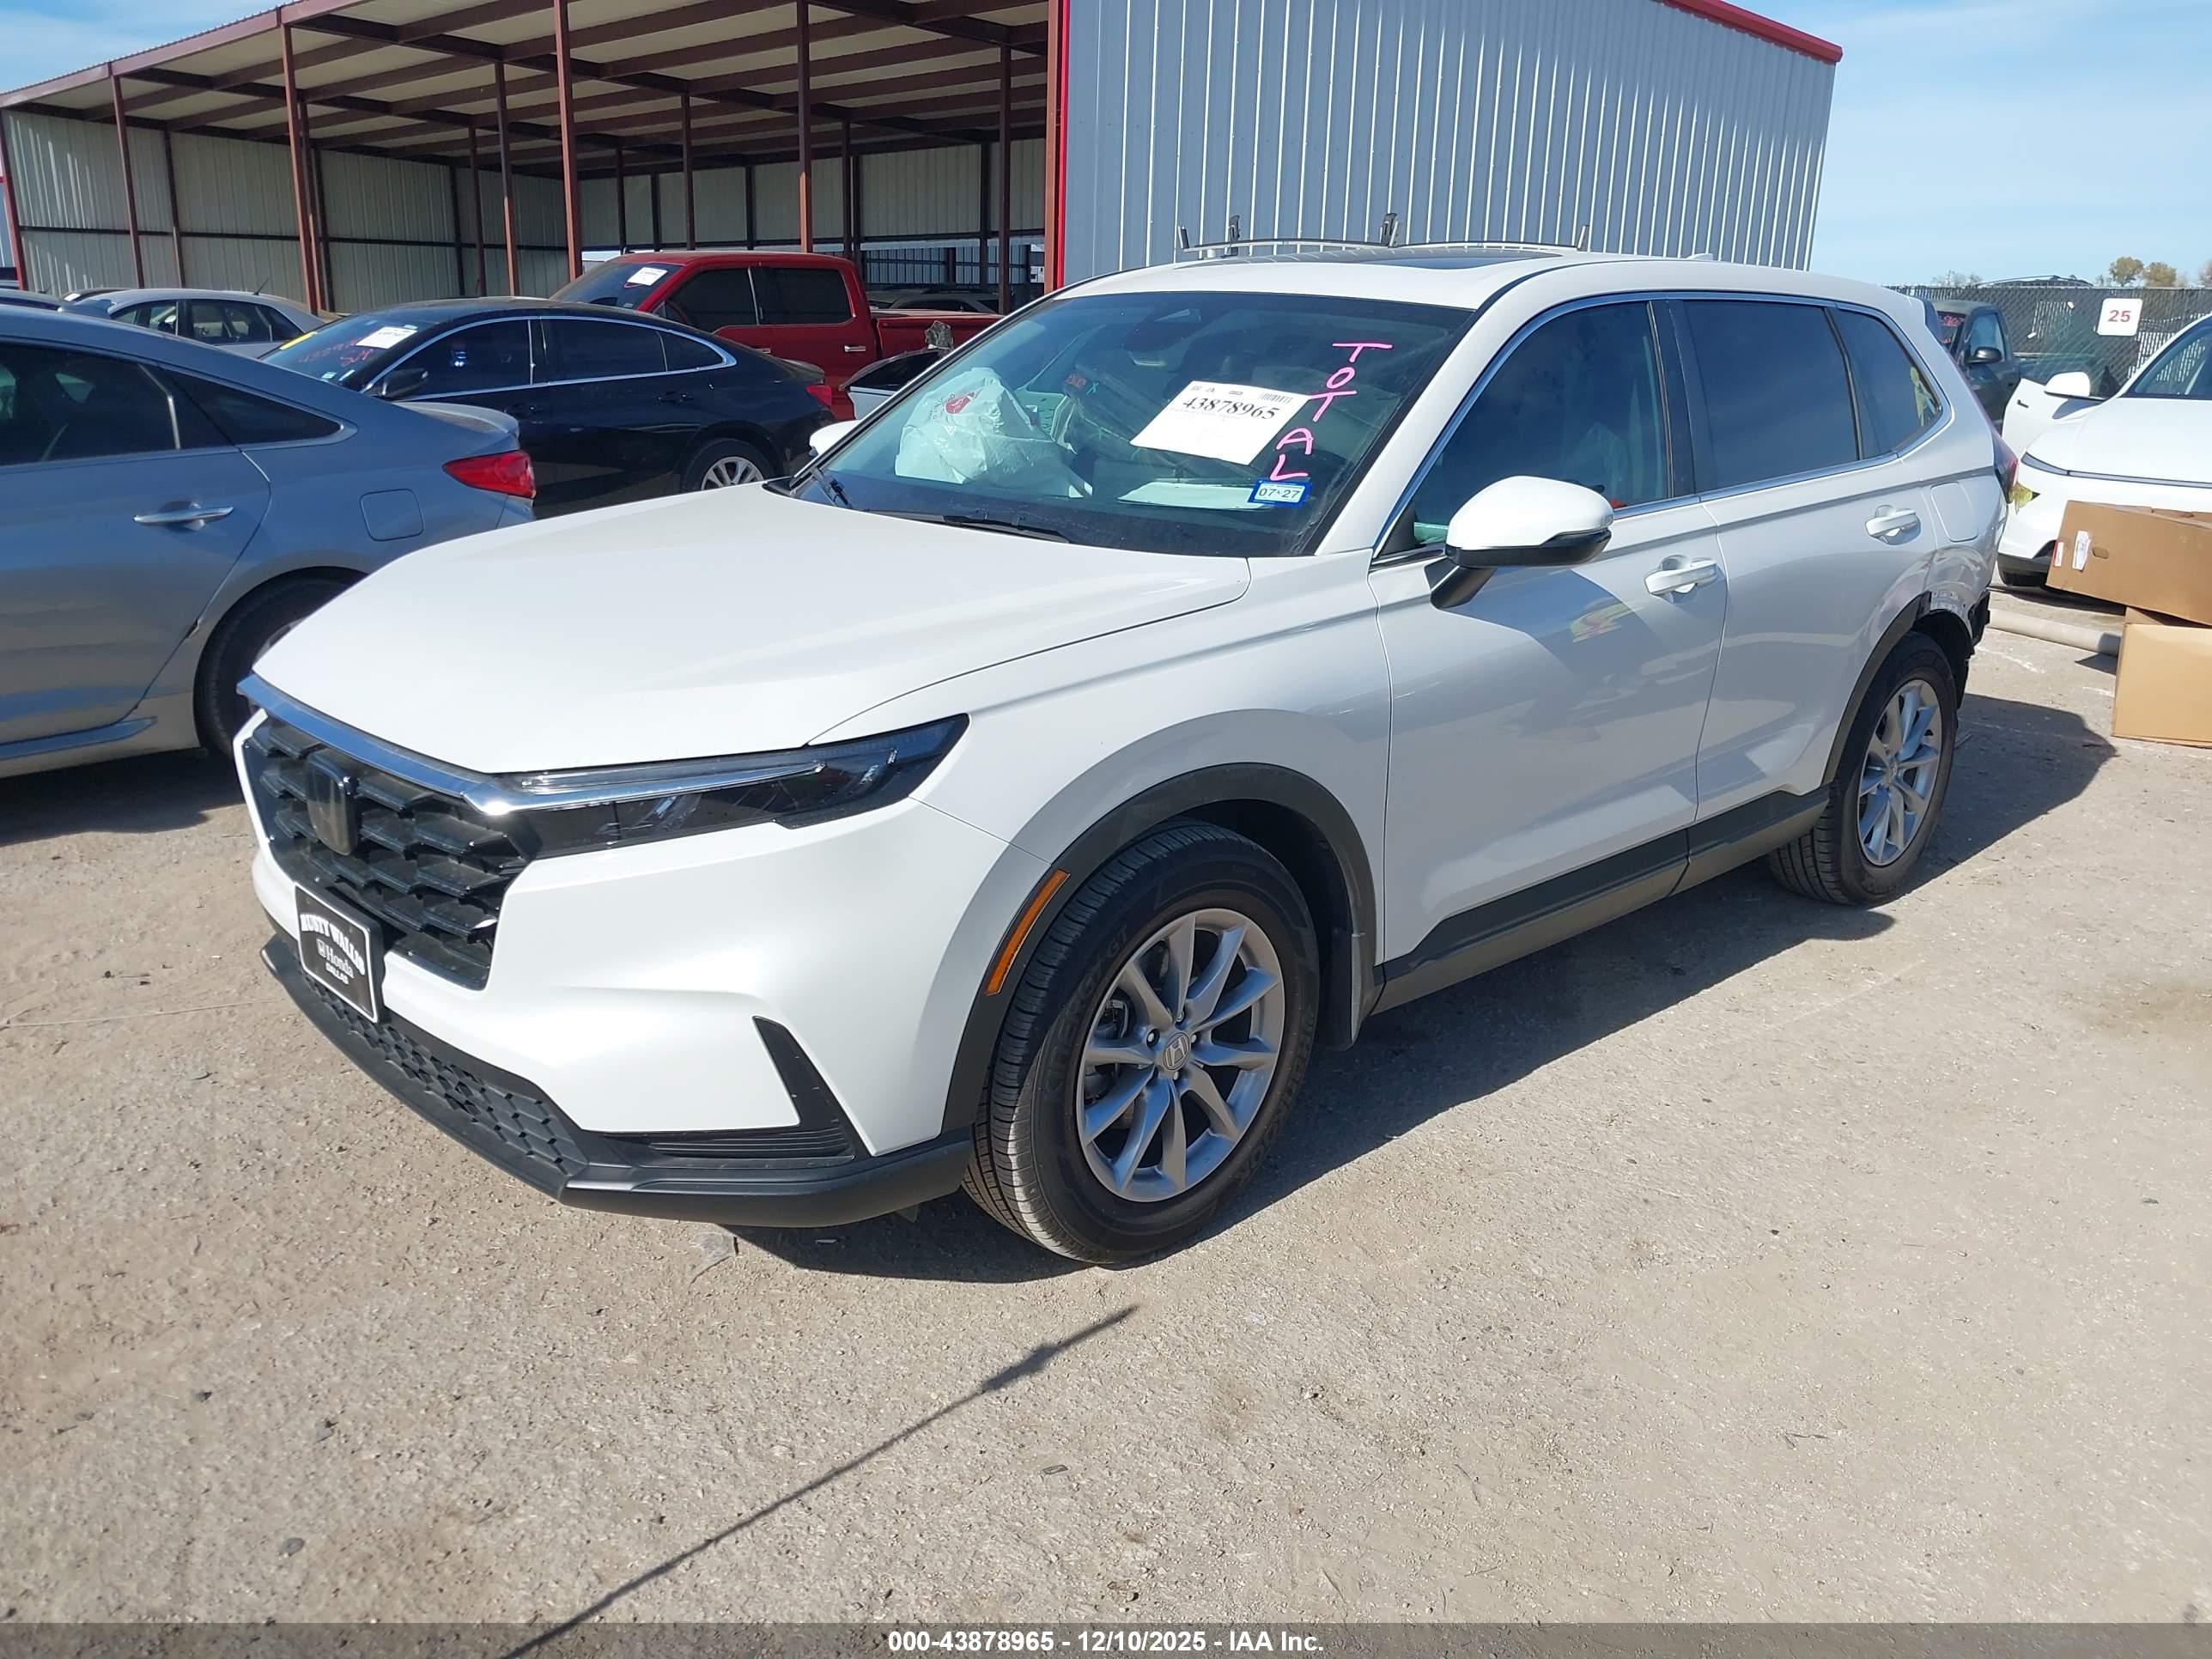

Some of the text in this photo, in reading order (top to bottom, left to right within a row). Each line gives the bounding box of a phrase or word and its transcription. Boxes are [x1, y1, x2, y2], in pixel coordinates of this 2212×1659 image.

[2107, 309, 2131, 323] 25
[1182, 397, 1280, 420] 43878965
[1270, 343, 1393, 481] TOTAL
[300, 914, 330, 938] RUSTY
